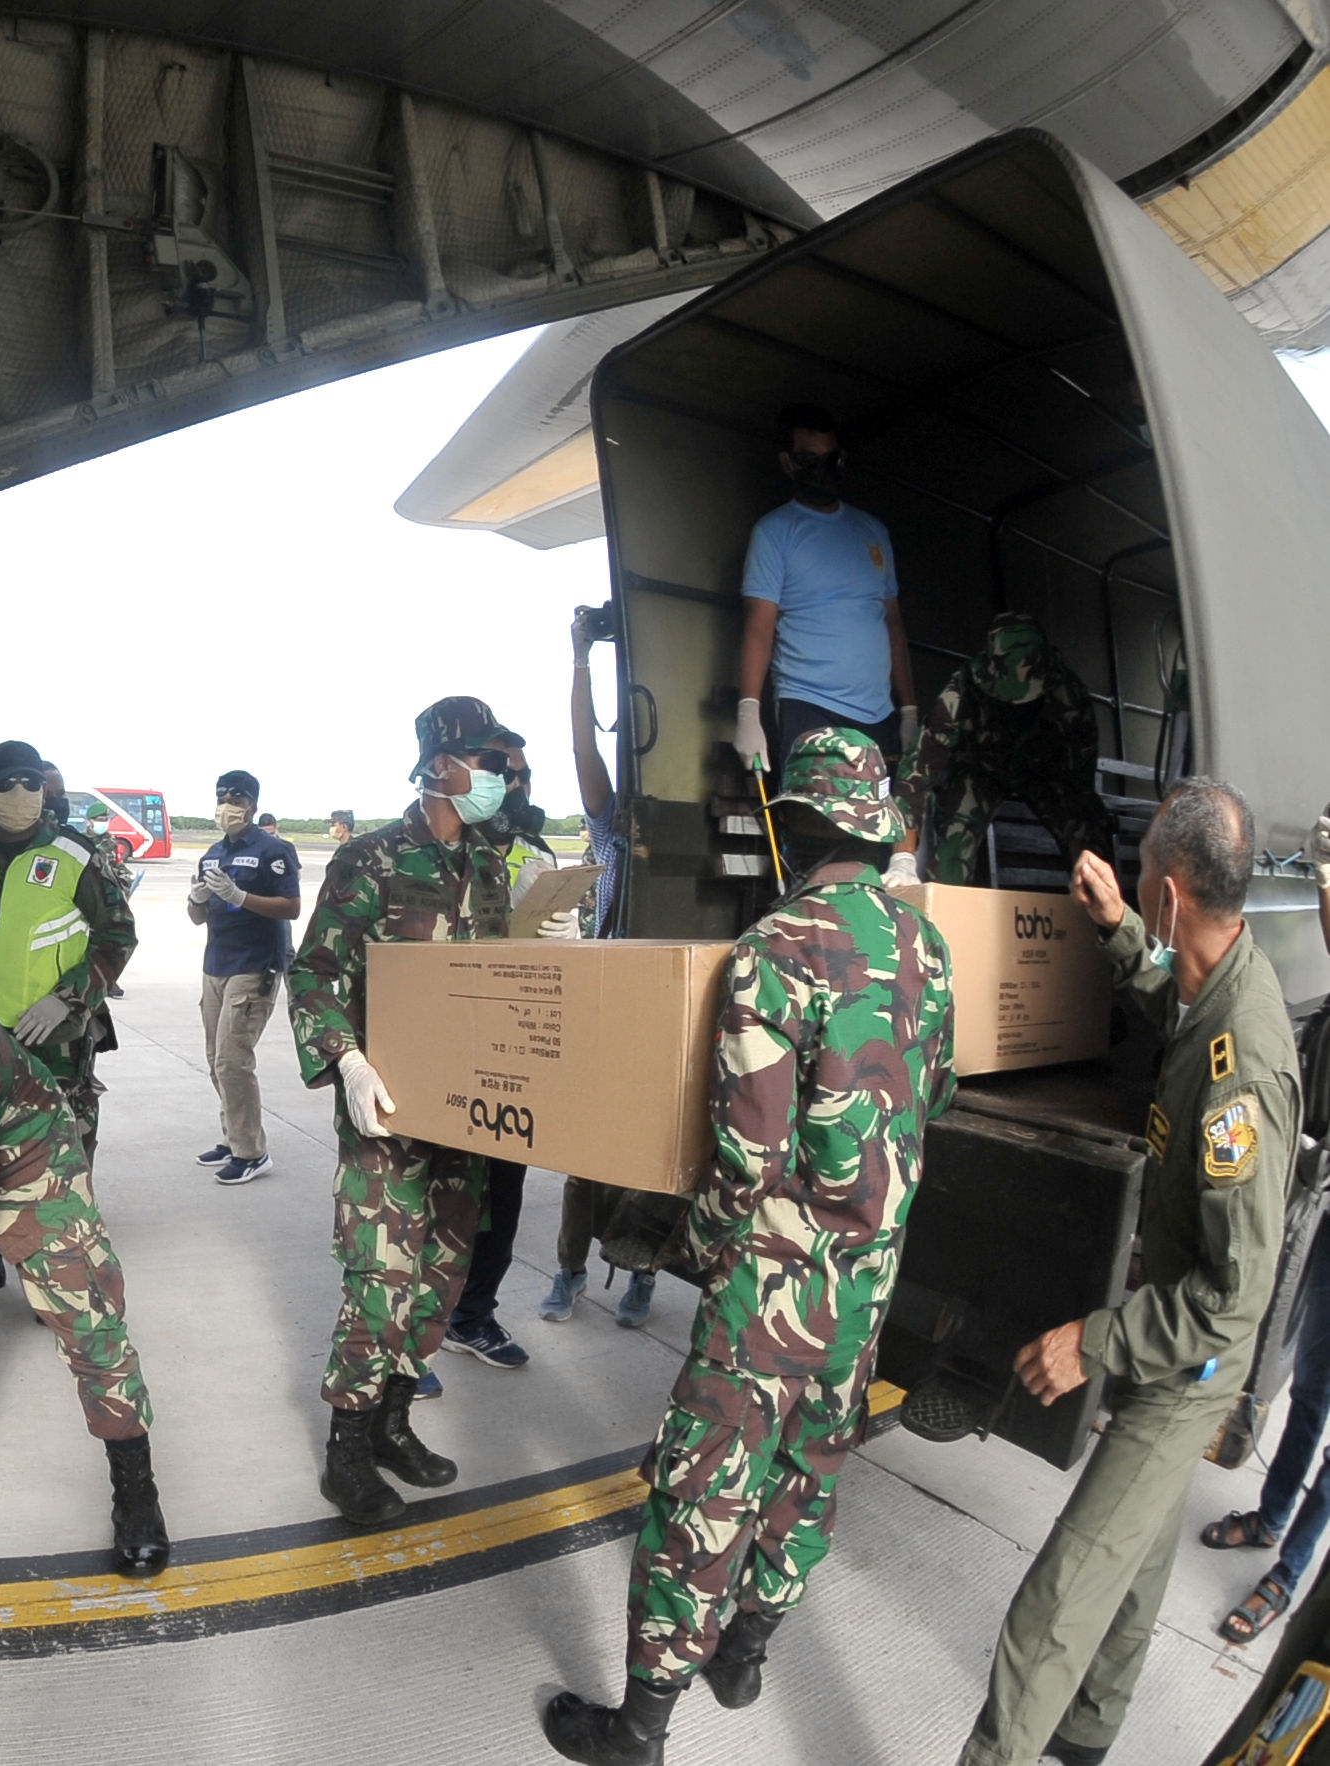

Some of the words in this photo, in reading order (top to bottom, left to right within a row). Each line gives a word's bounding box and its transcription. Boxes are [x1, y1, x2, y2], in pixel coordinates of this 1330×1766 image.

[1015, 906, 1053, 940] boho
[518, 1020, 536, 1030] White
[542, 1022, 561, 1032] Color
[529, 1034, 551, 1045] Pieces
[445, 1093, 468, 1109] 5601
[469, 1098, 534, 1149] boho
